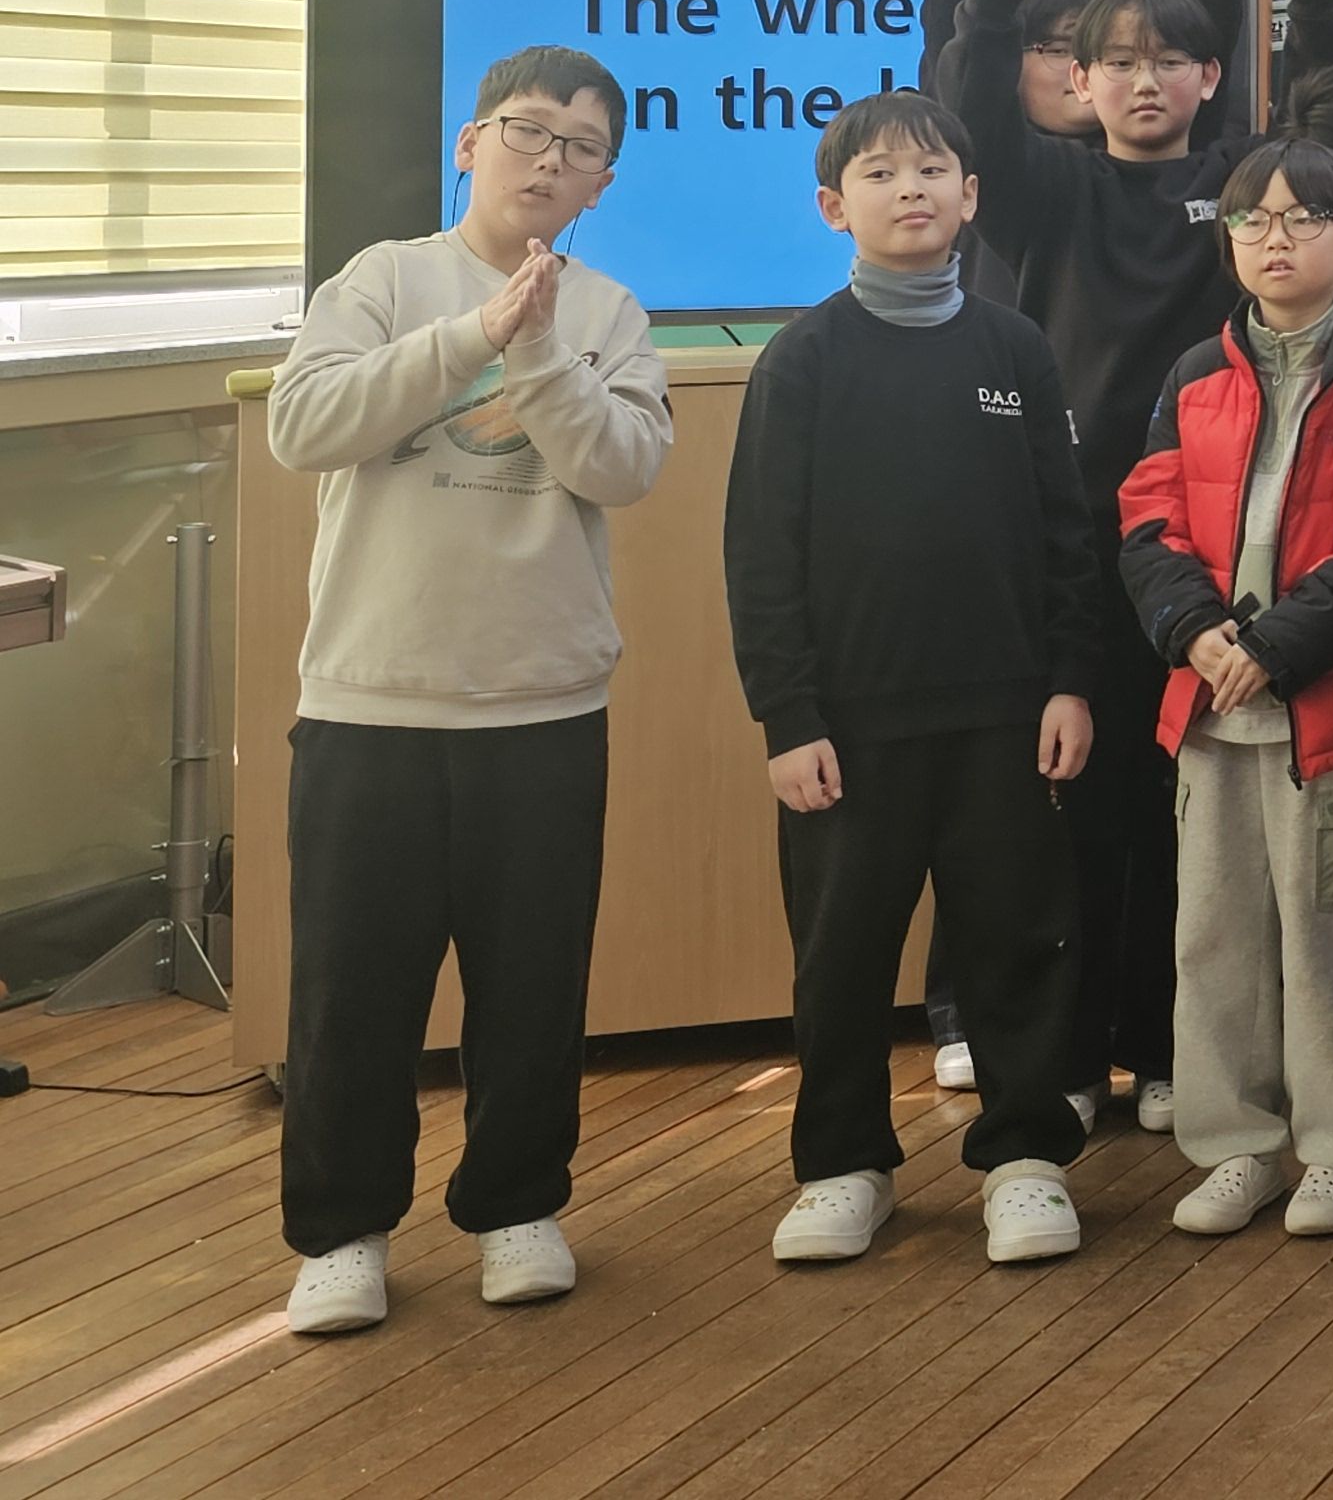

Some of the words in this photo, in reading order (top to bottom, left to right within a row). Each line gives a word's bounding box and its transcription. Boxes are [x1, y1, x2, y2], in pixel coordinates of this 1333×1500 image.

[634, 86, 679, 131] n
[715, 68, 843, 131] the
[453, 482, 504, 493] NATIONAL
